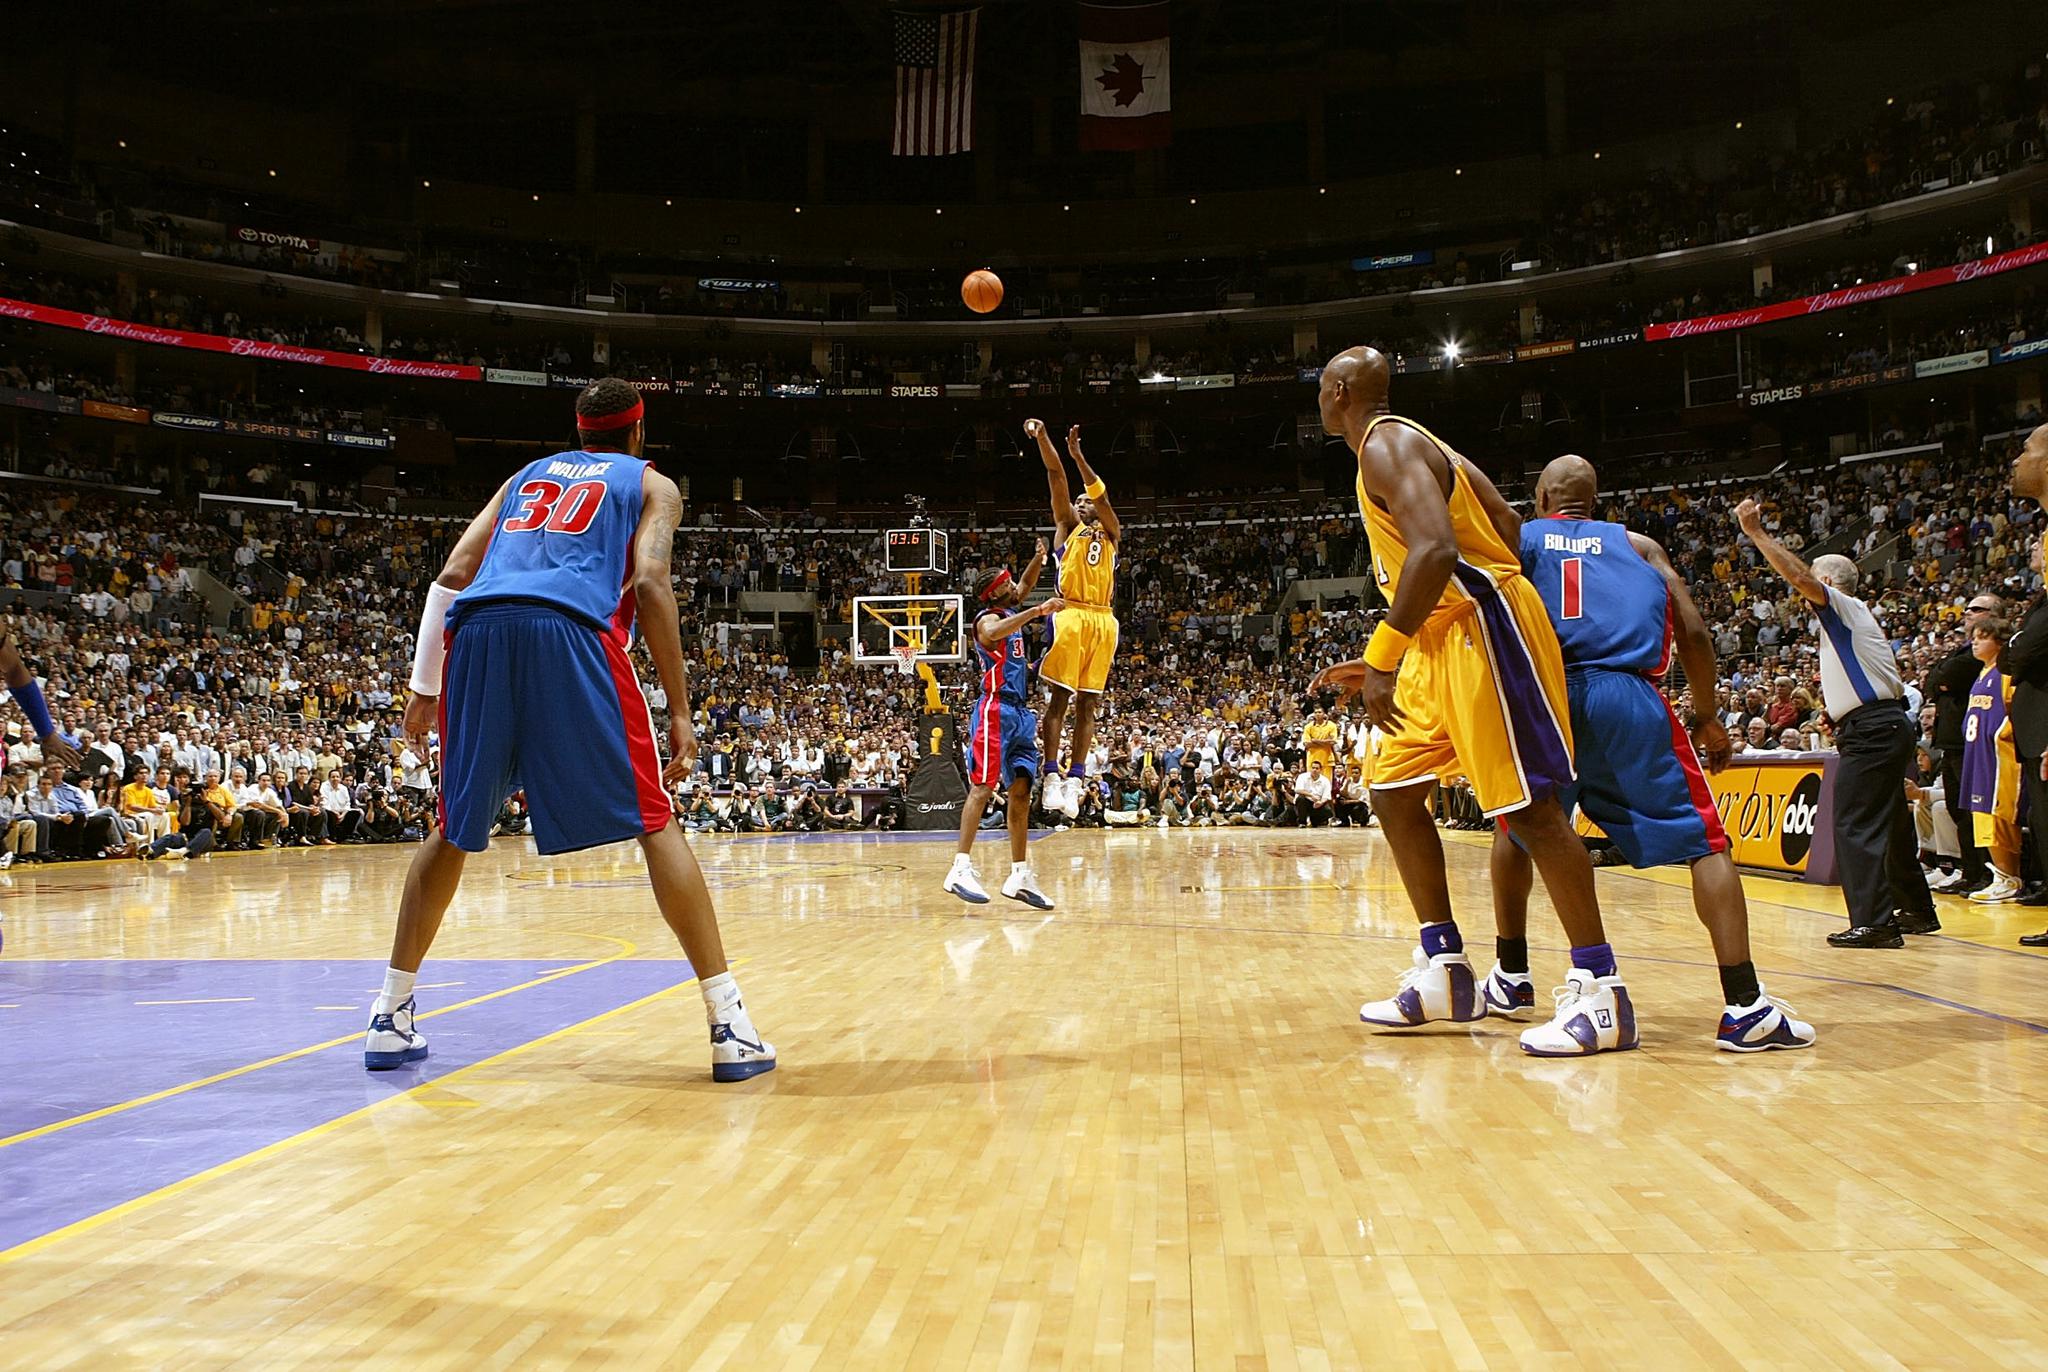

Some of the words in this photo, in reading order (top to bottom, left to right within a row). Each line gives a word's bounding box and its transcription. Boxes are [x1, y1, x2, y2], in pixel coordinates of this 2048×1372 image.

[259, 231, 309, 249] TOYOTA
[1380, 254, 1413, 266] PEPSI
[1952, 247, 2048, 283] Budweise
[1804, 283, 1905, 314] Budweiser
[82, 313, 184, 345] Budweiser
[1666, 312, 1763, 339] Budweiser
[1591, 333, 1639, 346] DIRECTV
[2012, 339, 2048, 357] PEPS
[228, 337, 325, 366] Budweiser
[1517, 350, 1531, 359] THE
[1551, 343, 1574, 353] DEPOT
[366, 355, 460, 380] Budweiser
[1941, 359, 1969, 370] America
[630, 381, 670, 391] TOYOTA
[1830, 373, 1877, 389] SPORTS
[1883, 367, 1908, 380] NET
[891, 386, 939, 398] STAPLES
[1750, 385, 1802, 406] STAPLES
[155, 415, 183, 424] BUD
[183, 417, 219, 428] LIGHT
[243, 423, 290, 437] SPORTS
[296, 429, 319, 440] NET
[546, 461, 613, 480] WALLACE
[503, 480, 607, 535] 30
[890, 532, 920, 545] 03.6
[1544, 534, 1602, 555] BILLUPS
[1087, 541, 1102, 566] 8
[1561, 557, 1582, 620] 1
[1013, 638, 1026, 659] 3
[1965, 714, 1980, 742] 8
[1740, 792, 1787, 842] ON
[1782, 794, 1818, 835] abc
